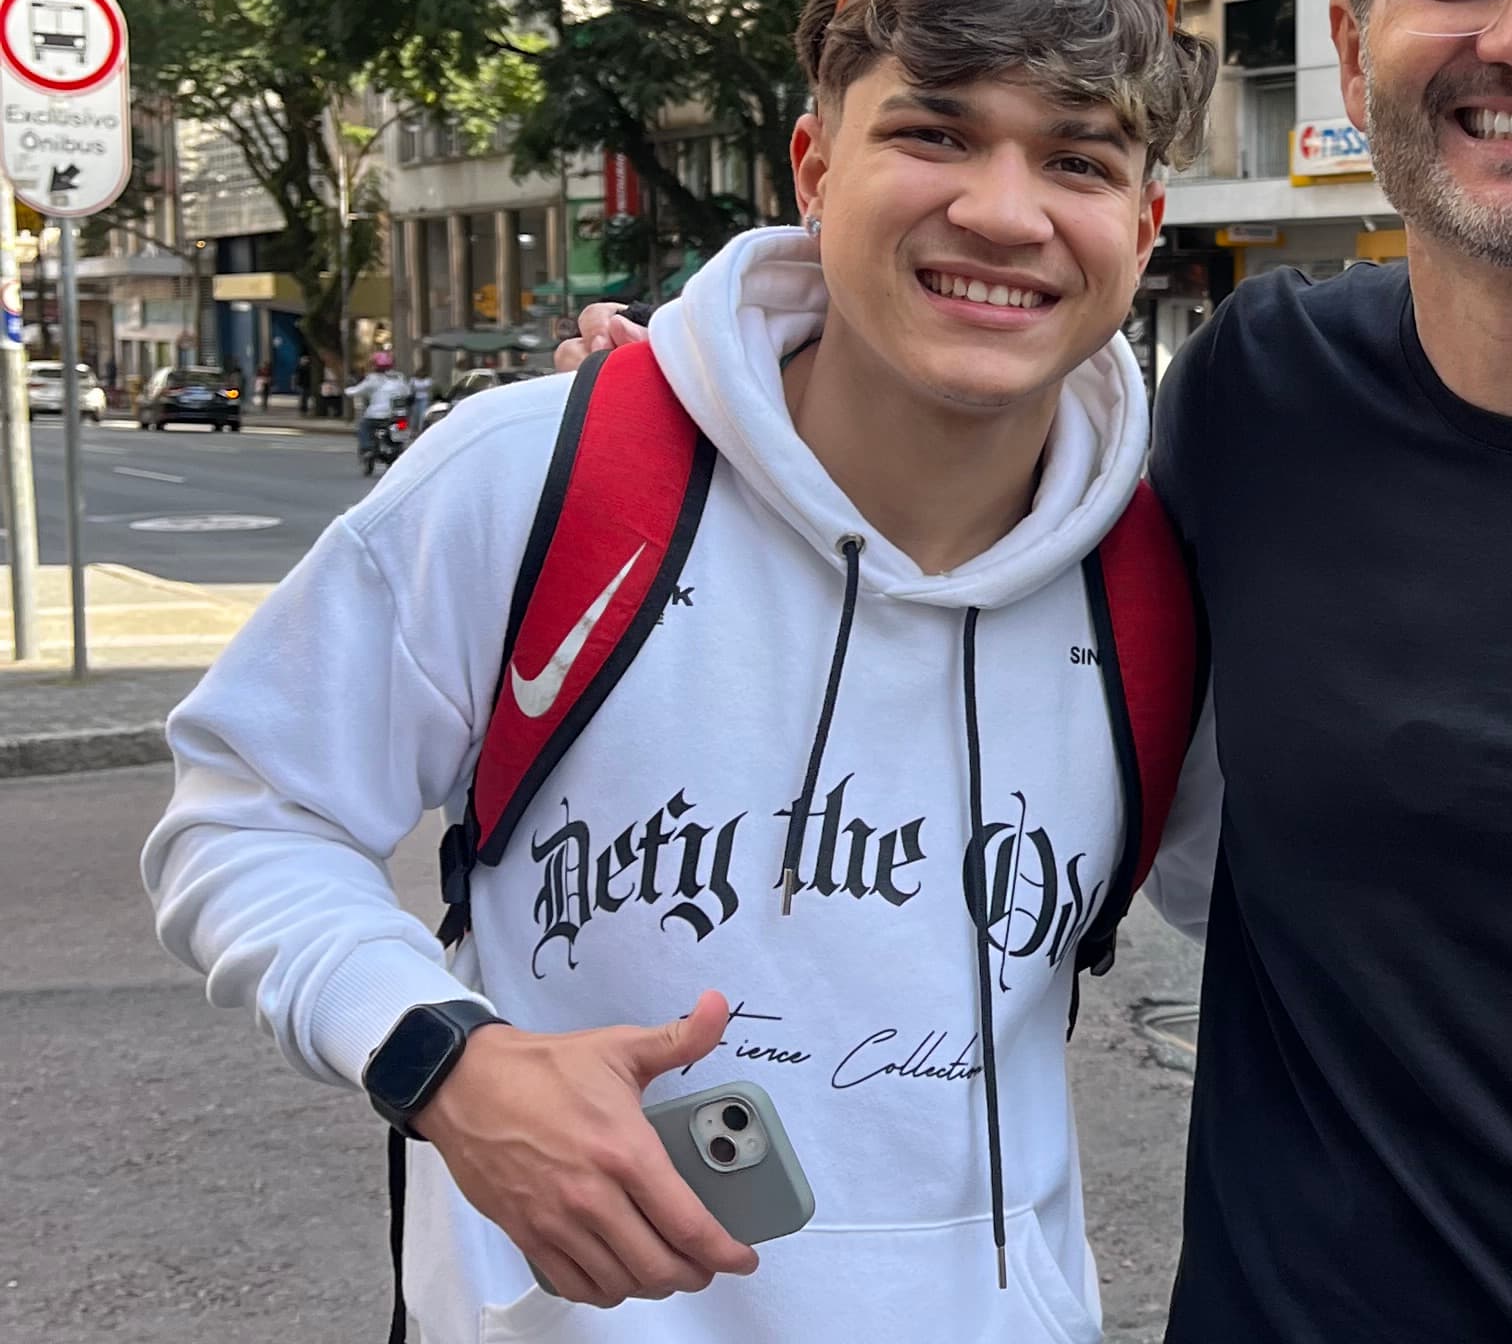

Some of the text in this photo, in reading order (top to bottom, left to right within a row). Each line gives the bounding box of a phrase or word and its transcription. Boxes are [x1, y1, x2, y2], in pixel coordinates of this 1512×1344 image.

[6, 104, 119, 130] Exclusivo
[531, 787, 748, 980] Defy
[773, 772, 927, 907] the
